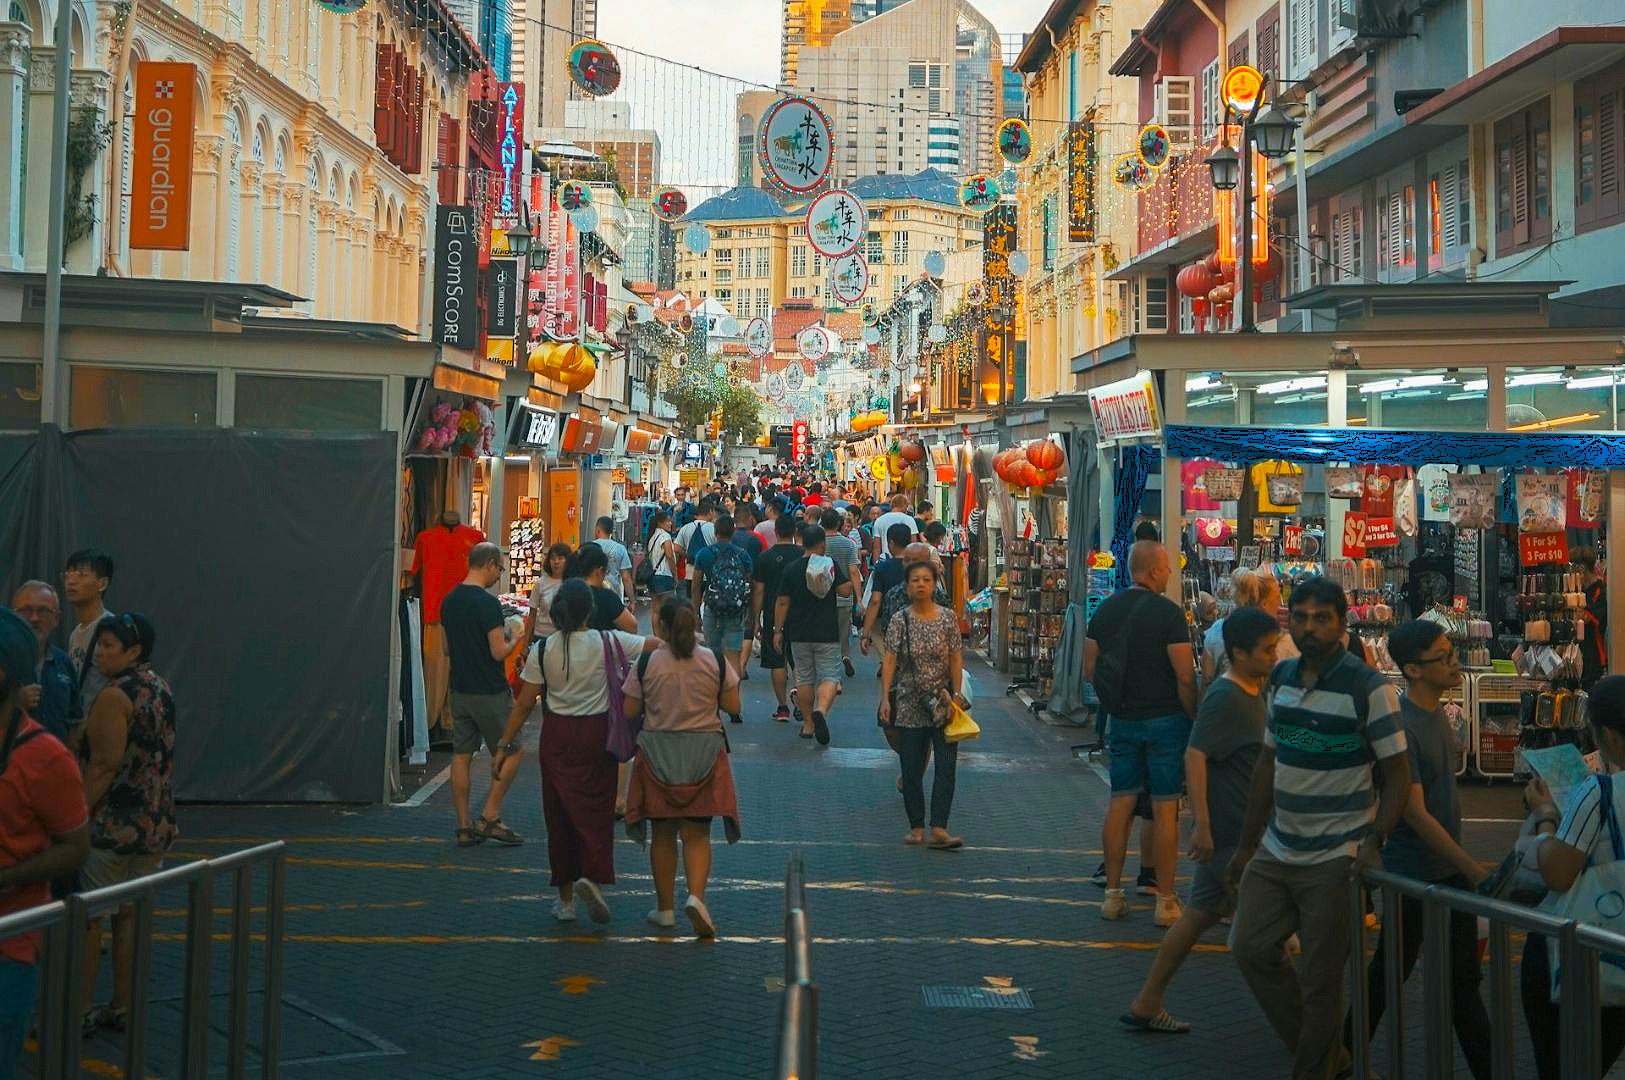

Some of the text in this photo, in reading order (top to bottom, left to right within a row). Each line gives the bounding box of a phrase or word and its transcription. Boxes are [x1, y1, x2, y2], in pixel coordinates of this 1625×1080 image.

[501, 84, 518, 212] ATLANTIS
[149, 108, 176, 231] guardian
[491, 247, 512, 256] Niko
[548, 210, 560, 278] CHINATOWN
[1344, 516, 1366, 549] $2
[1526, 535, 1557, 546] 1 For $4
[1527, 550, 1562, 561] 3 For $10
